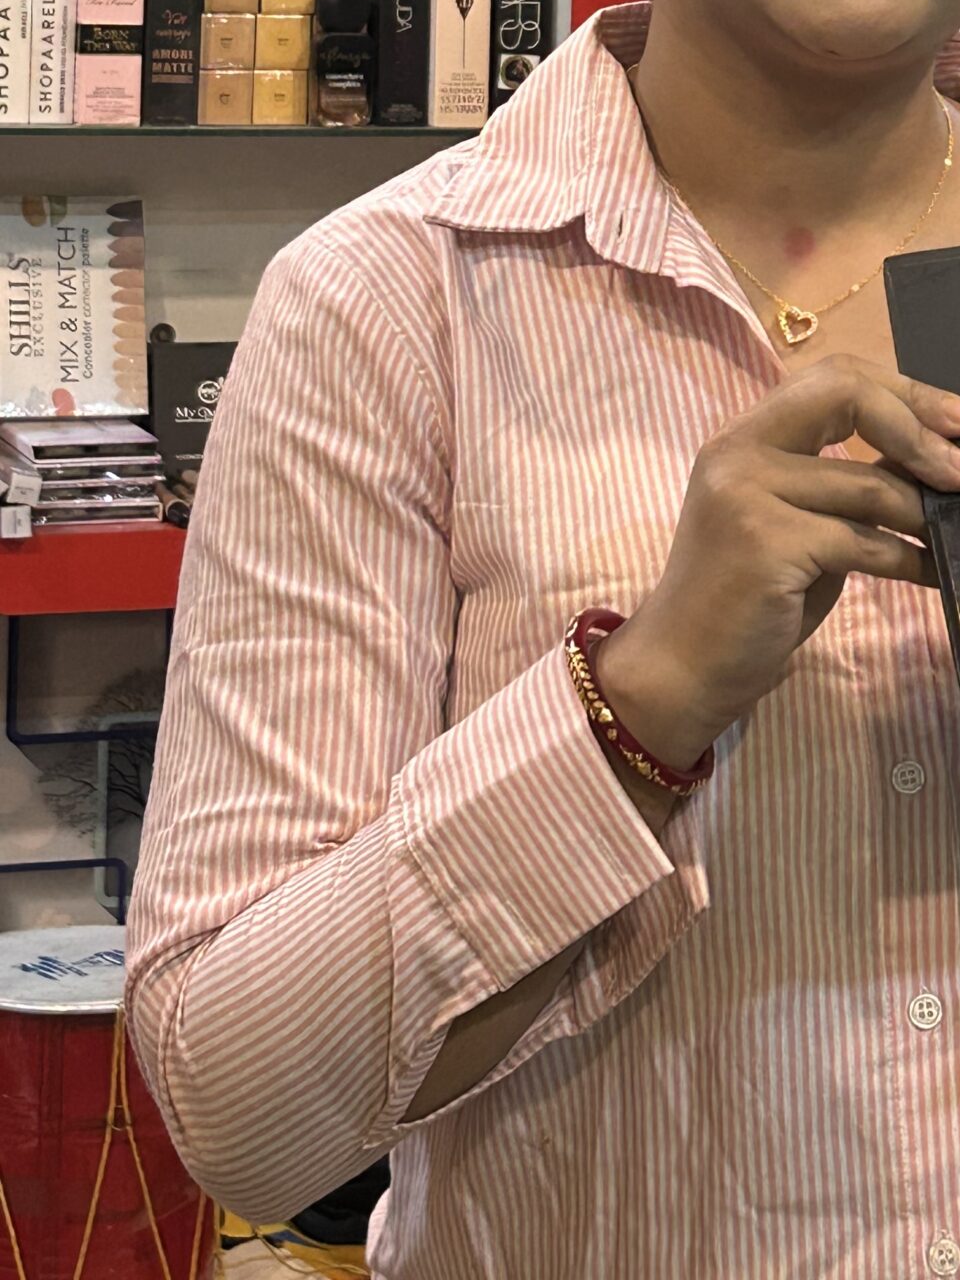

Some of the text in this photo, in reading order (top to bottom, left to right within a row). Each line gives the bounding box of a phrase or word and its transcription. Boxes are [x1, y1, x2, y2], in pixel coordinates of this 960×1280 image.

[8, 256, 32, 358] SHILLS
[32, 257, 45, 358] EXCLUSIVE
[57, 226, 80, 383] MIX & MATCH
